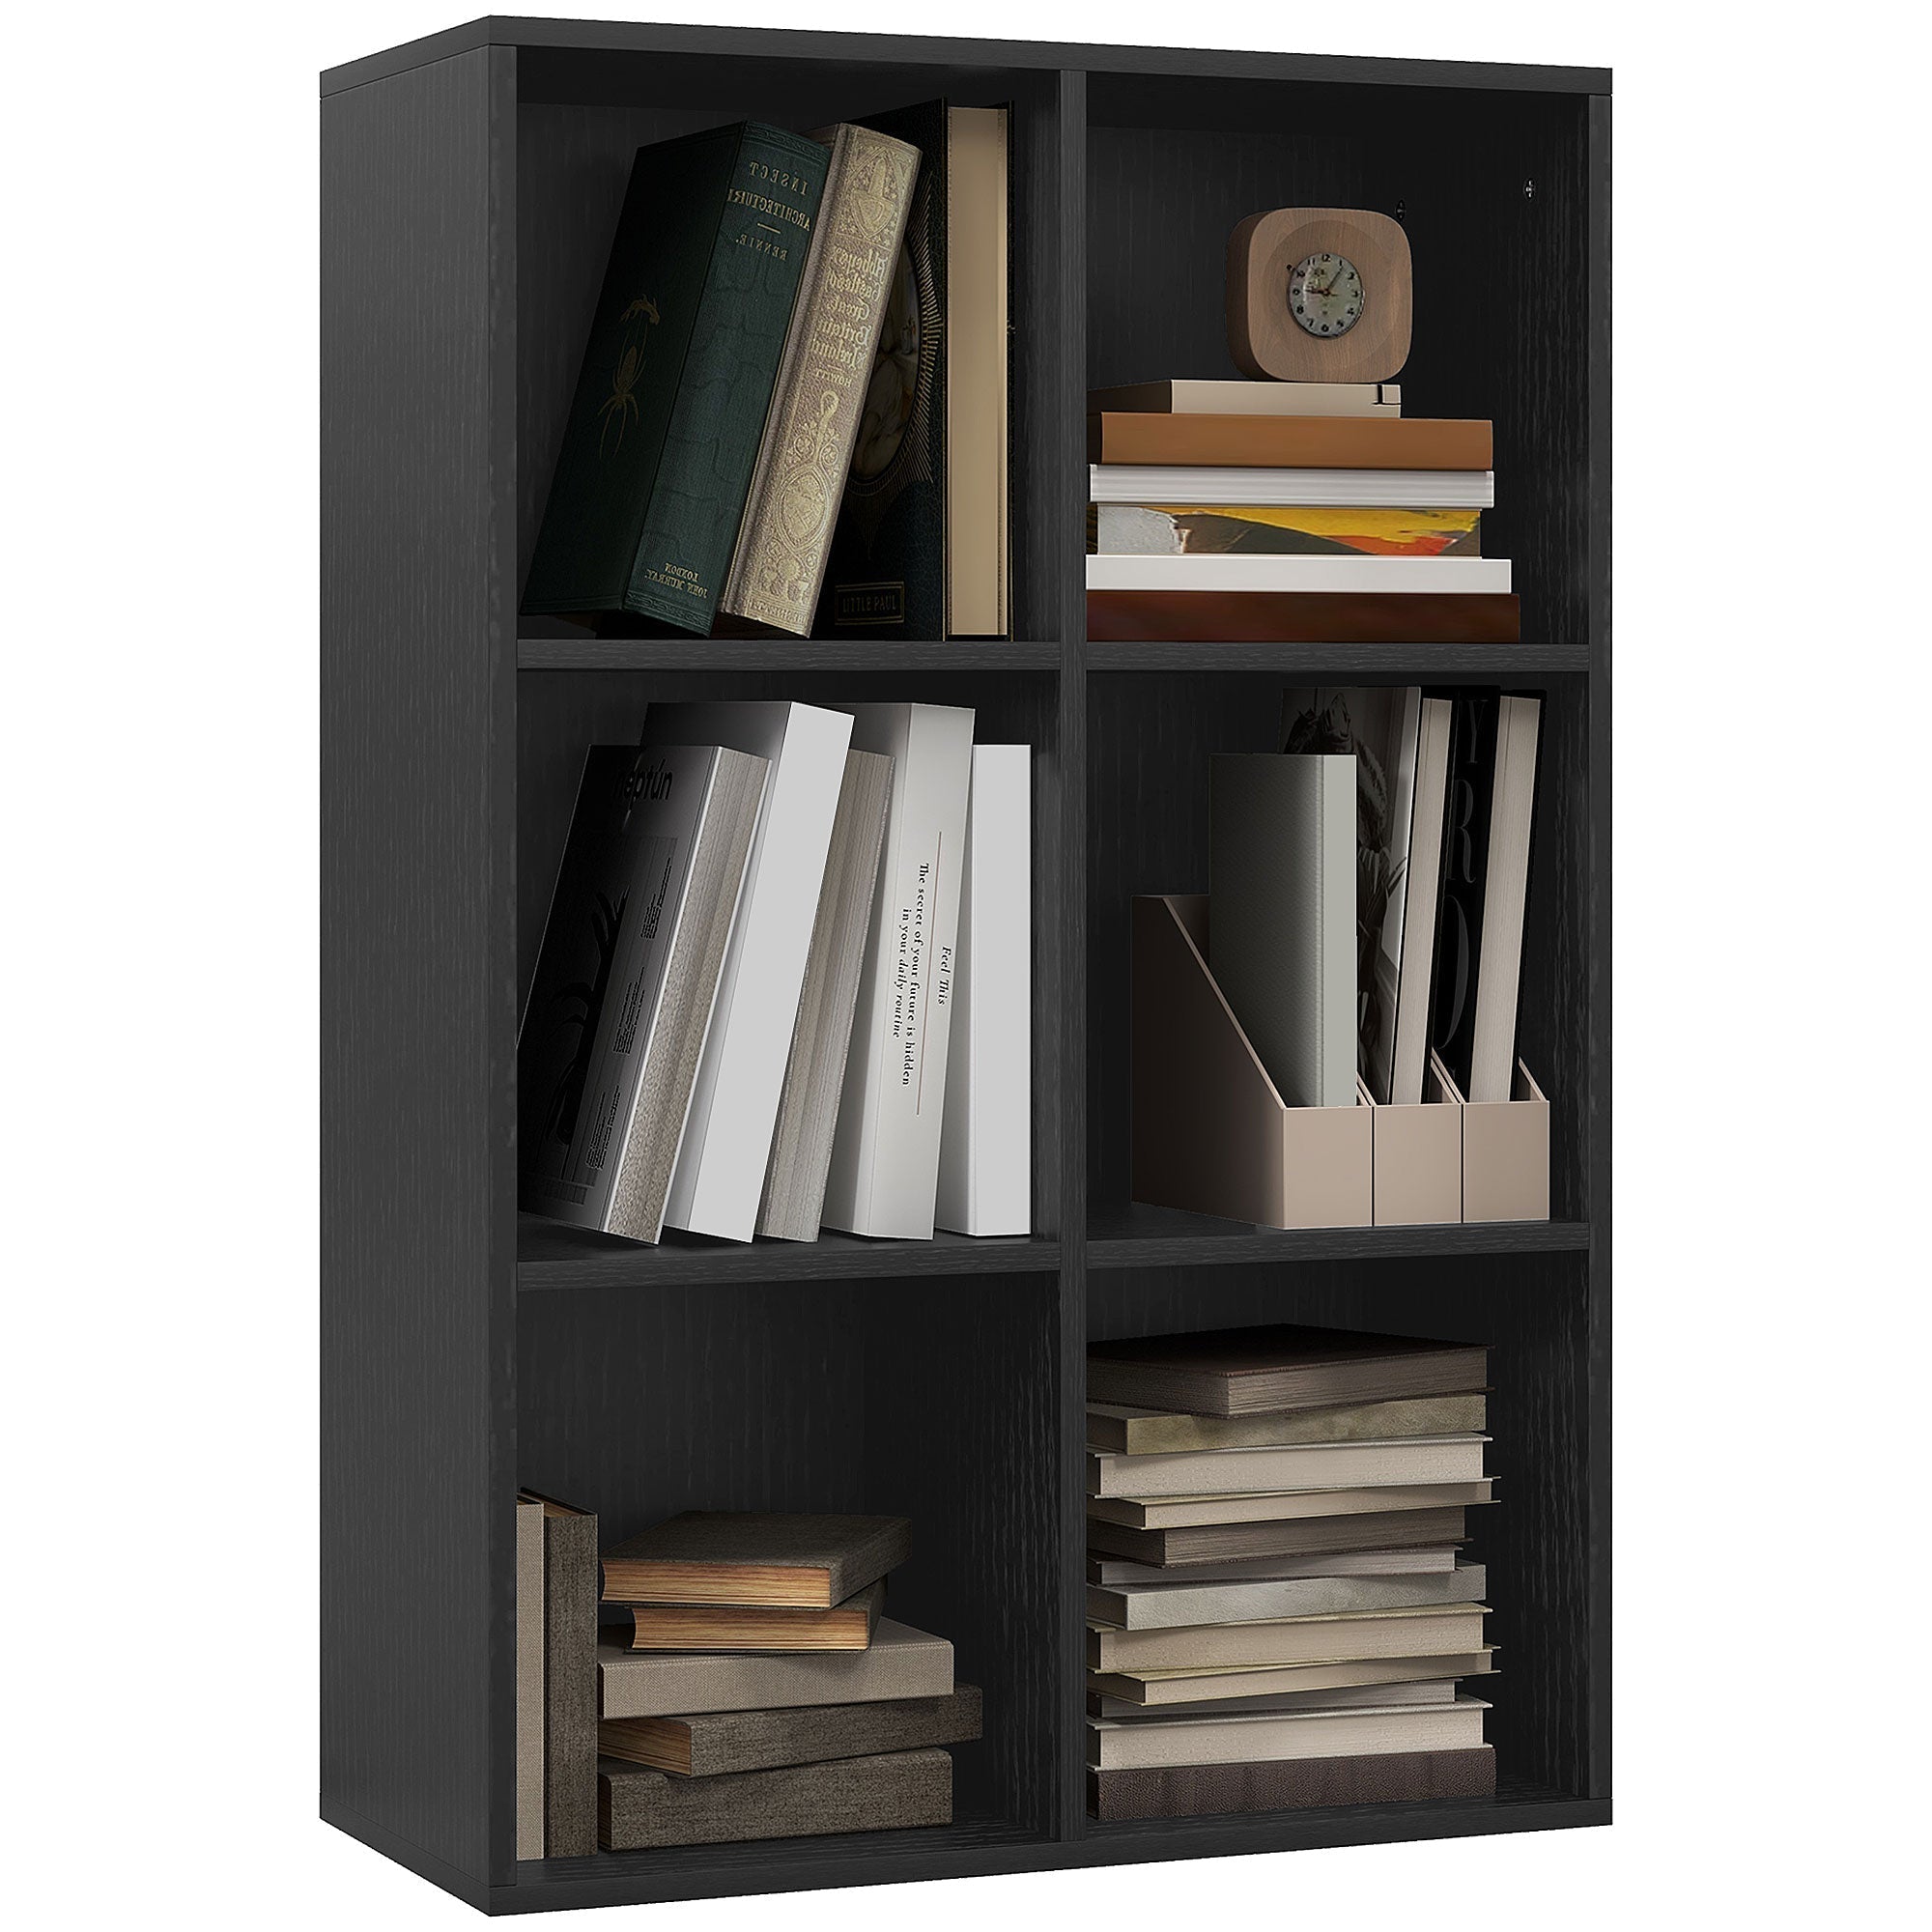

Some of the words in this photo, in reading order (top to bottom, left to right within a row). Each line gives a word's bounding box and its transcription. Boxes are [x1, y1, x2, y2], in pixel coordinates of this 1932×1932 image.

[841, 595, 872, 613] LITTLE
[873, 594, 897, 612] PAUL
[919, 863, 929, 883] The
[902, 908, 912, 921] in
[915, 888, 924, 925] secret
[898, 924, 909, 955] your
[914, 931, 924, 946] of
[894, 958, 909, 990] daily
[910, 948, 920, 977] your
[940, 946, 952, 974] Feel
[908, 981, 921, 1021] future
[938, 979, 950, 1005] This
[893, 994, 903, 1038] routine
[906, 1027, 916, 1037] is
[902, 1041, 916, 1085] hidden
